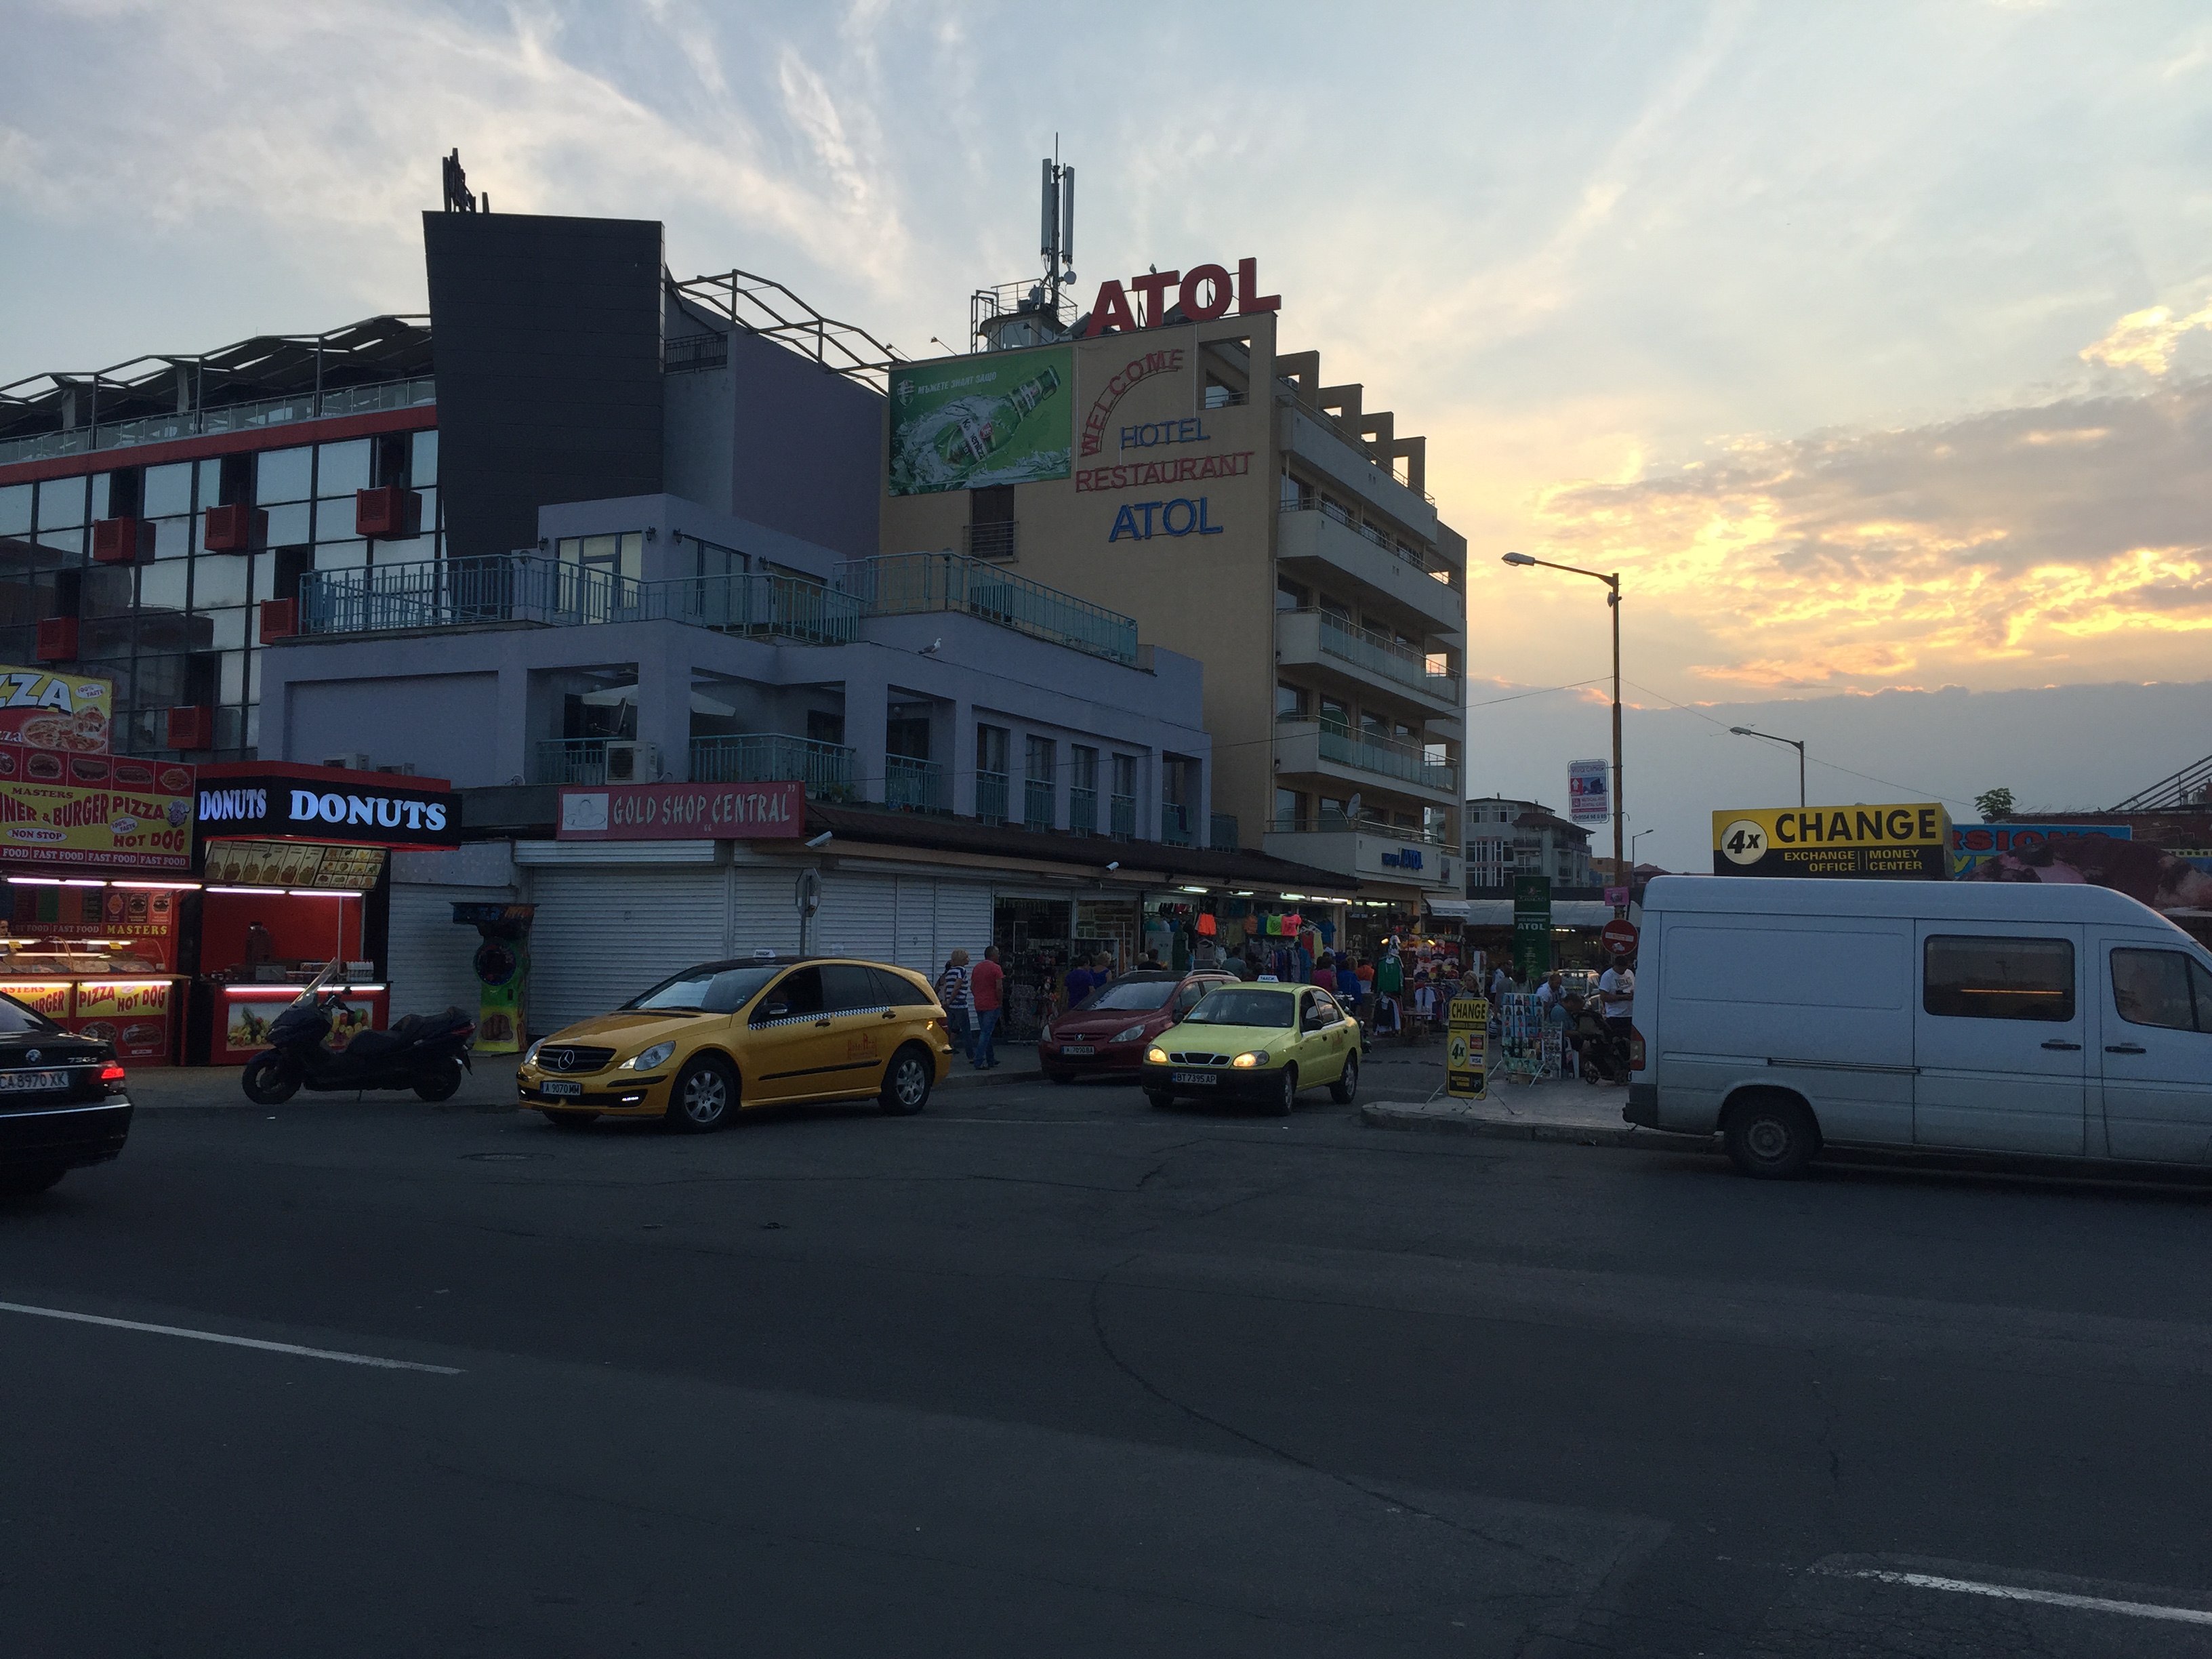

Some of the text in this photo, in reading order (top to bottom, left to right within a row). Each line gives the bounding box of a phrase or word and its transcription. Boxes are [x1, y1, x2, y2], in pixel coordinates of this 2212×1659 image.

[1085, 258, 1282, 337] ATOL
[918, 381, 949, 395] МЪЖЕТЕ
[975, 371, 998, 384] ЗАЩО
[1081, 348, 1185, 457] WELCOME
[1120, 417, 1211, 450] HOTEL
[1076, 451, 1255, 493] RESTAURANT
[1108, 497, 1224, 543] ATOL
[12, 787, 74, 799] MASTERS
[199, 788, 267, 821] DONUTS
[0, 792, 108, 827] NER & BURGER
[112, 796, 165, 820] PIZZA
[289, 790, 447, 831] DONUTS
[613, 795, 657, 825] GOLD
[661, 794, 707, 825] SHOP
[12, 829, 62, 841] NON STOP
[1776, 808, 1937, 843] CHANGE
[113, 834, 146, 848] HOT
[150, 828, 184, 853] DOG
[1727, 830, 1761, 854] 4x
[3, 848, 186, 866] FOOD FAST FOOD FAST FOOD FAST FOOD
[1784, 849, 1919, 862] EXCHANGE MONEY
[1809, 861, 1922, 872] OFFICE CENTER
[26, 924, 49, 933] FOOD
[76, 925, 100, 933] FOOD
[106, 925, 167, 935] MASTERS
[27, 990, 66, 1014] URGER
[79, 986, 115, 1008] PIZZA
[117, 985, 166, 1012] HOT DOG
[1452, 1002, 1486, 1019] CHANGE
[1452, 1044, 1464, 1060] 4x
[50, 1071, 66, 1086] XK
